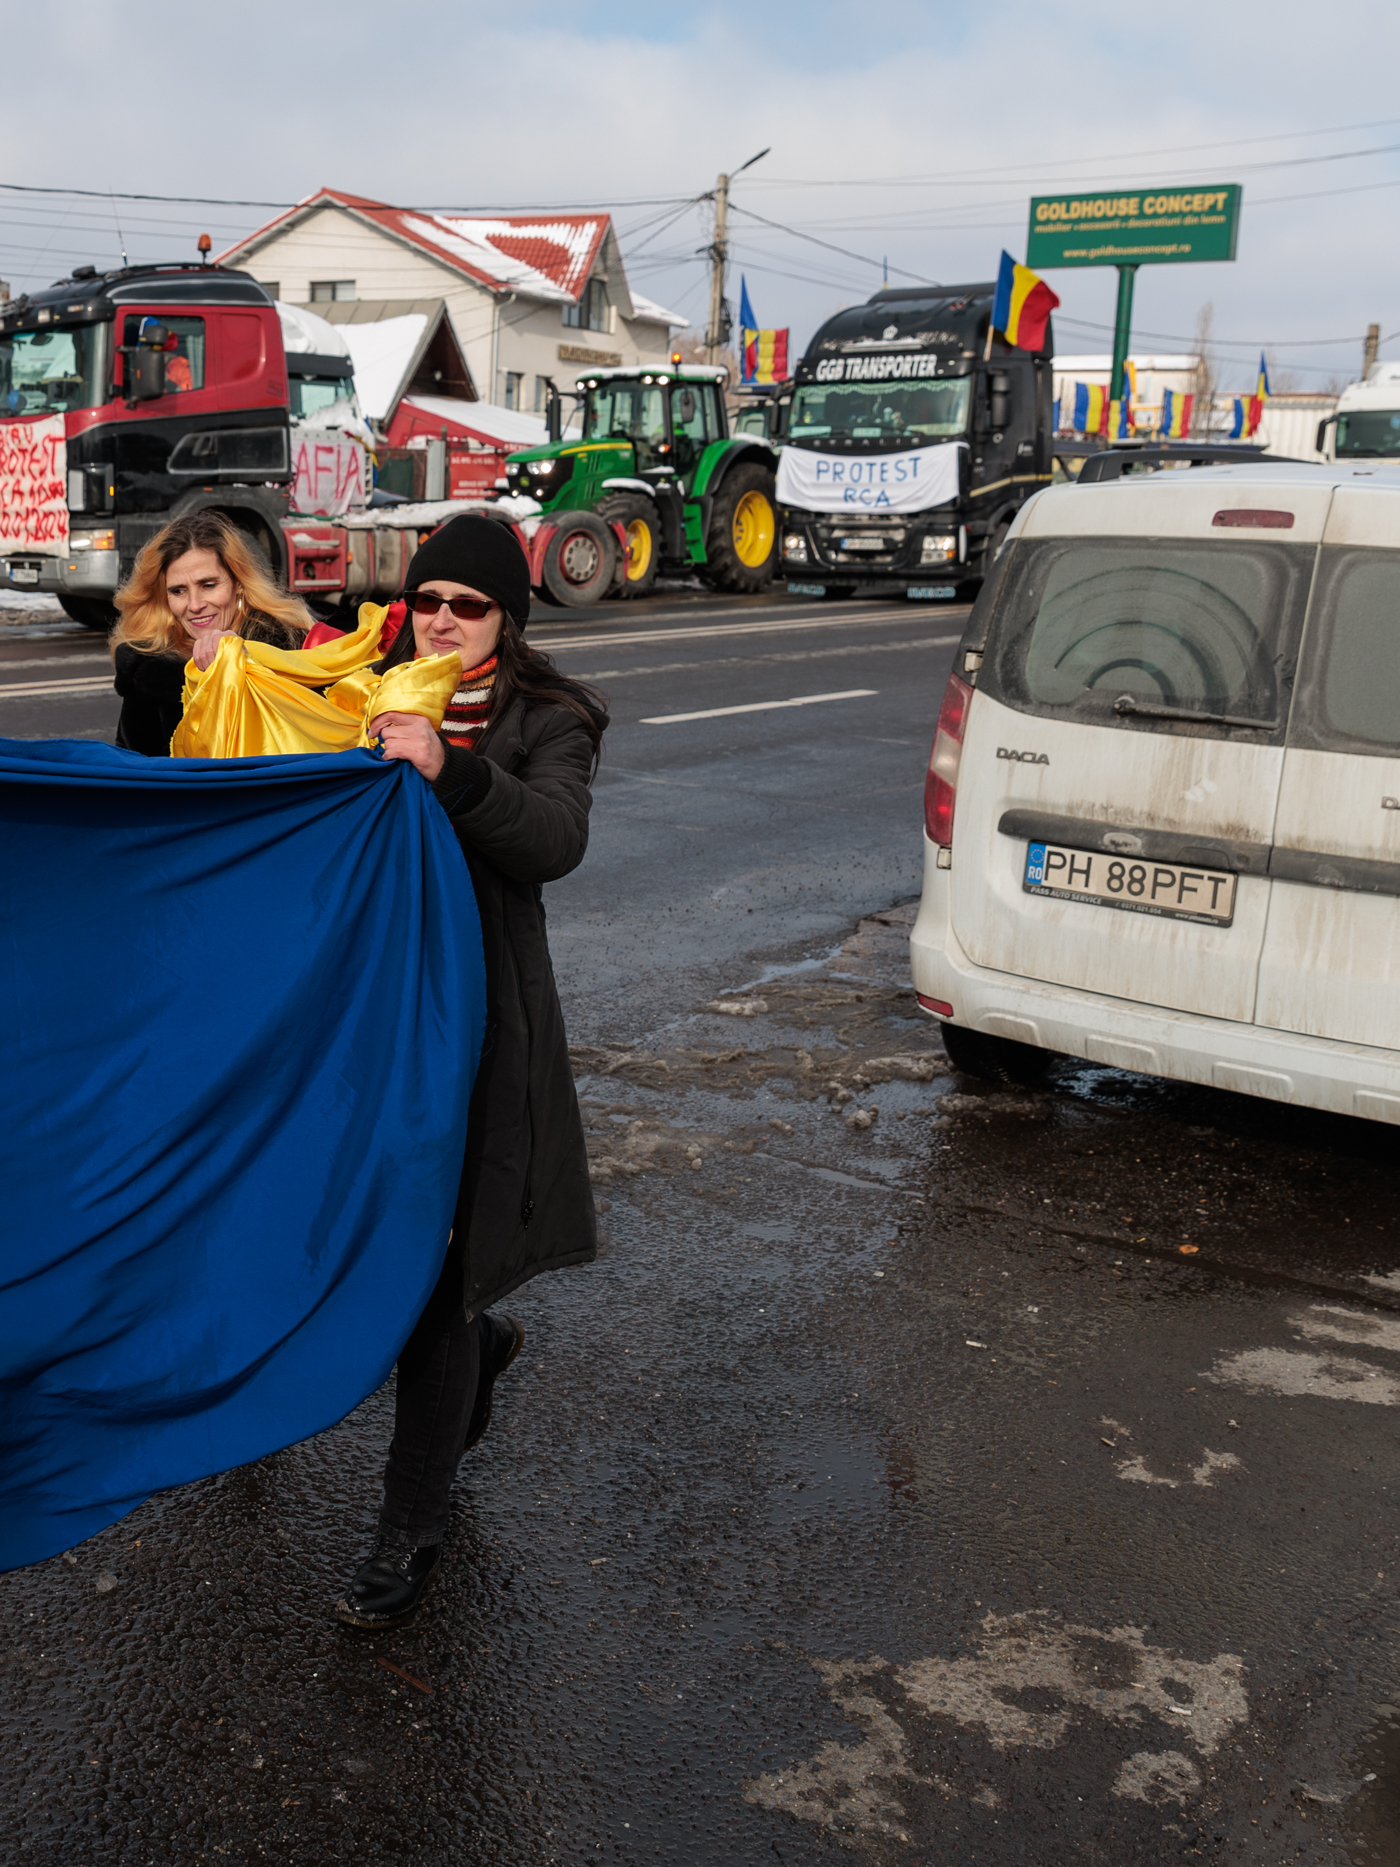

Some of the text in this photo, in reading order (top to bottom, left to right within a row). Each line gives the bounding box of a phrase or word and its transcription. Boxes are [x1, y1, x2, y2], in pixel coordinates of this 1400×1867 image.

[1036, 192, 1228, 222] GOLDHOUSE CONCEPT
[1034, 222, 1073, 234] mobilier
[816, 354, 937, 382] GGB TRANSPORTER
[293, 441, 363, 500] AFIA
[816, 457, 922, 483] PROTEST
[843, 486, 891, 508] RCA
[787, 582, 827, 597] IVECO
[907, 586, 957, 599] IVECO
[996, 747, 1050, 766] DACIA
[1028, 865, 1043, 881] RO
[1043, 850, 1092, 888] PH
[1030, 886, 1050, 897] PASS
[1049, 890, 1071, 900] AUTO
[1071, 893, 1103, 905] SERVICE
